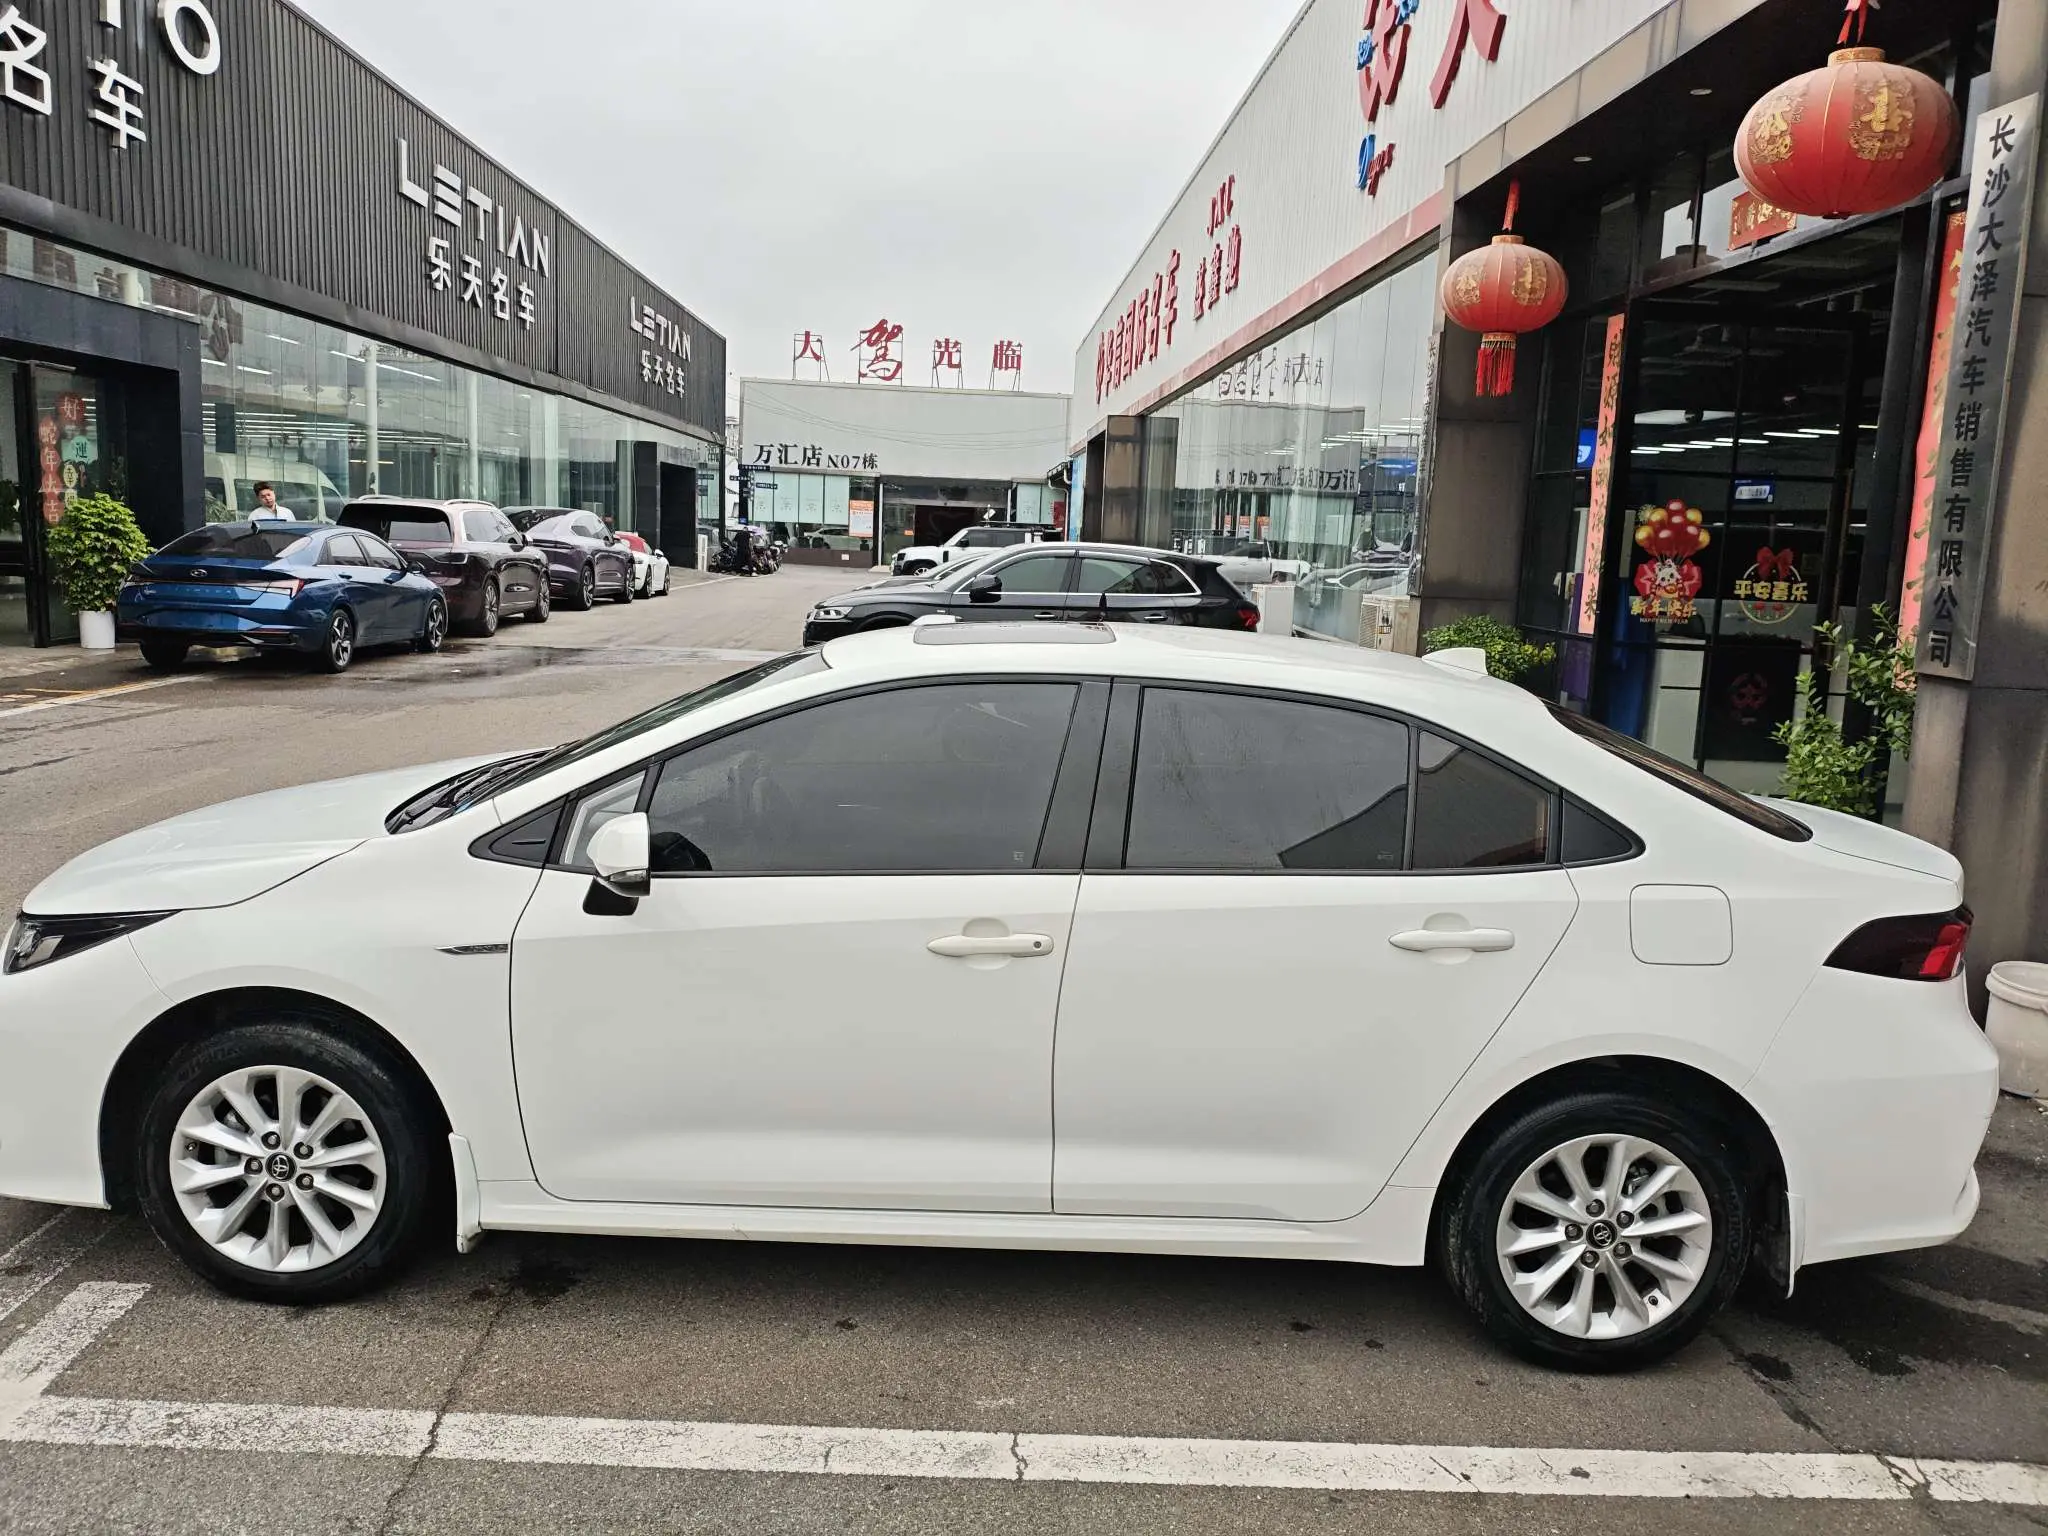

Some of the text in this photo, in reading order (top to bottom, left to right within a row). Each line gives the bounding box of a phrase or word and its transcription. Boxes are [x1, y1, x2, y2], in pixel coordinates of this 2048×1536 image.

[0, 5, 148, 150] 名车
[398, 136, 549, 279] LETIAN
[428, 235, 536, 331] 乐天名车
[629, 295, 692, 363] LETIAN
[794, 318, 1023, 382] 大驾光临
[640, 350, 685, 398] 乐天名车
[1928, 113, 2016, 668] 长沙大泽汽车销售有限公司
[1630, 598, 1697, 618] 新年快乐
[1734, 580, 1808, 601] 平安喜乐
